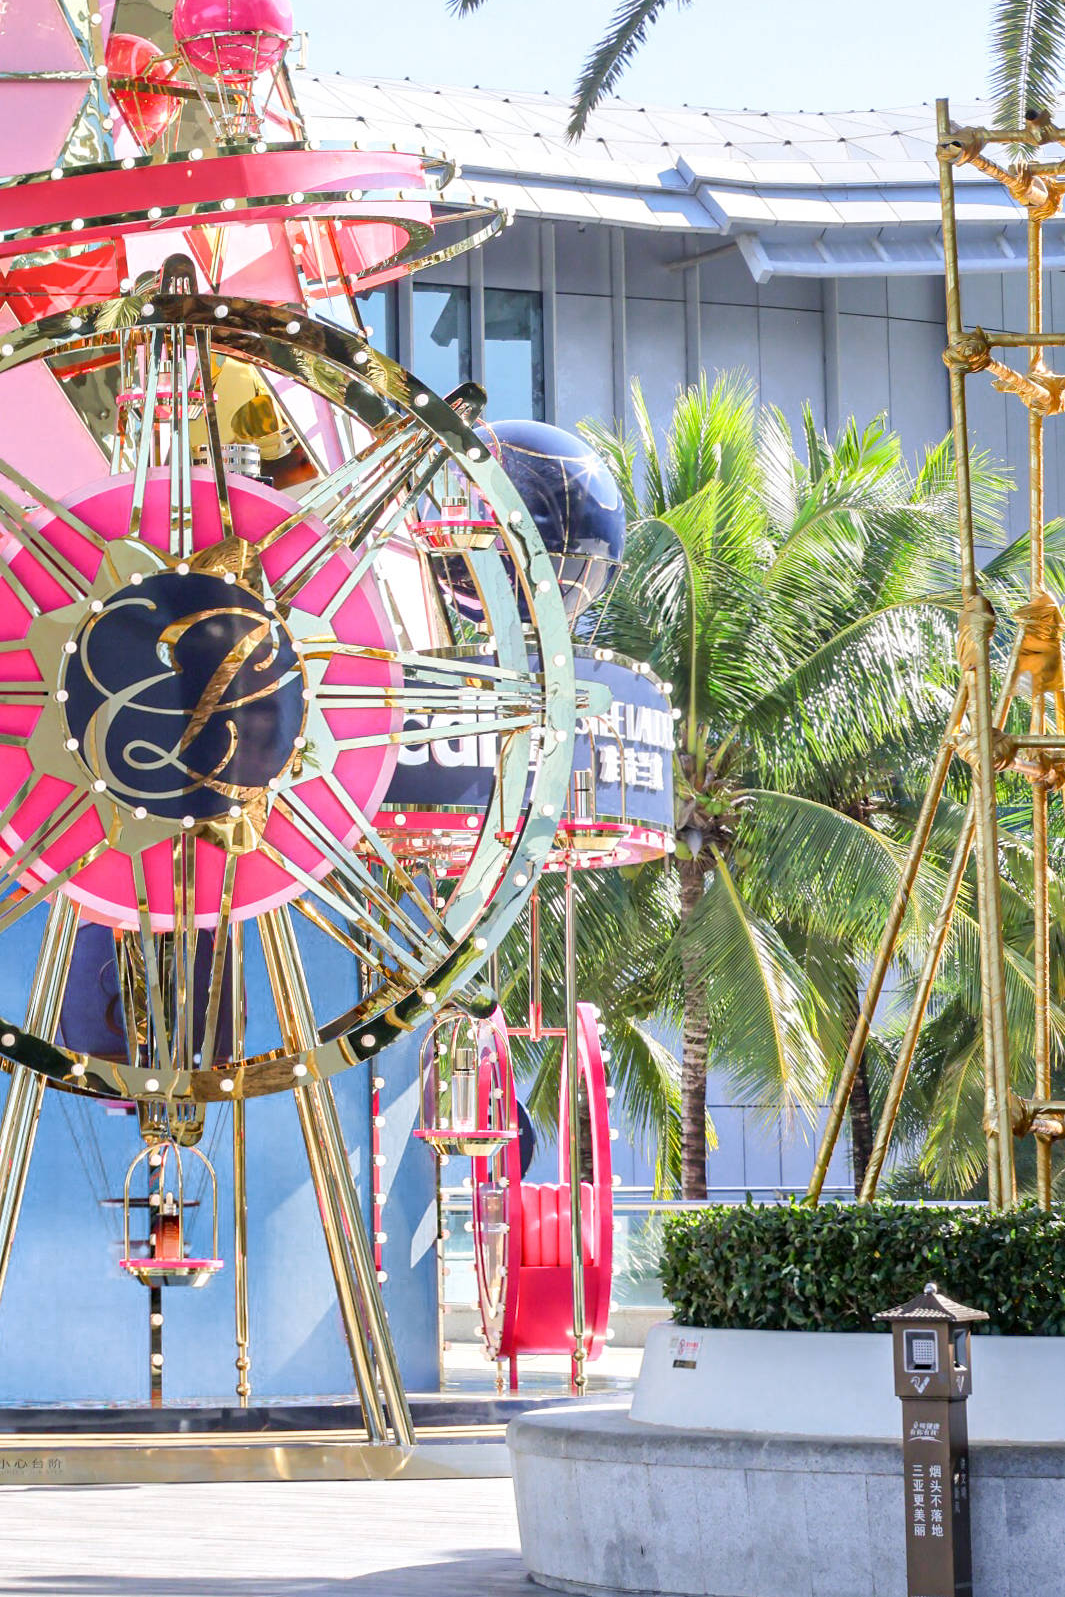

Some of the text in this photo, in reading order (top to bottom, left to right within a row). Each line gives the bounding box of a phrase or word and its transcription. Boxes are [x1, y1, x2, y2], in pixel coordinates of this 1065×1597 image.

[911, 1464, 926, 1538] 三亚更美丽
[929, 1464, 944, 1538] 烟头不落地
